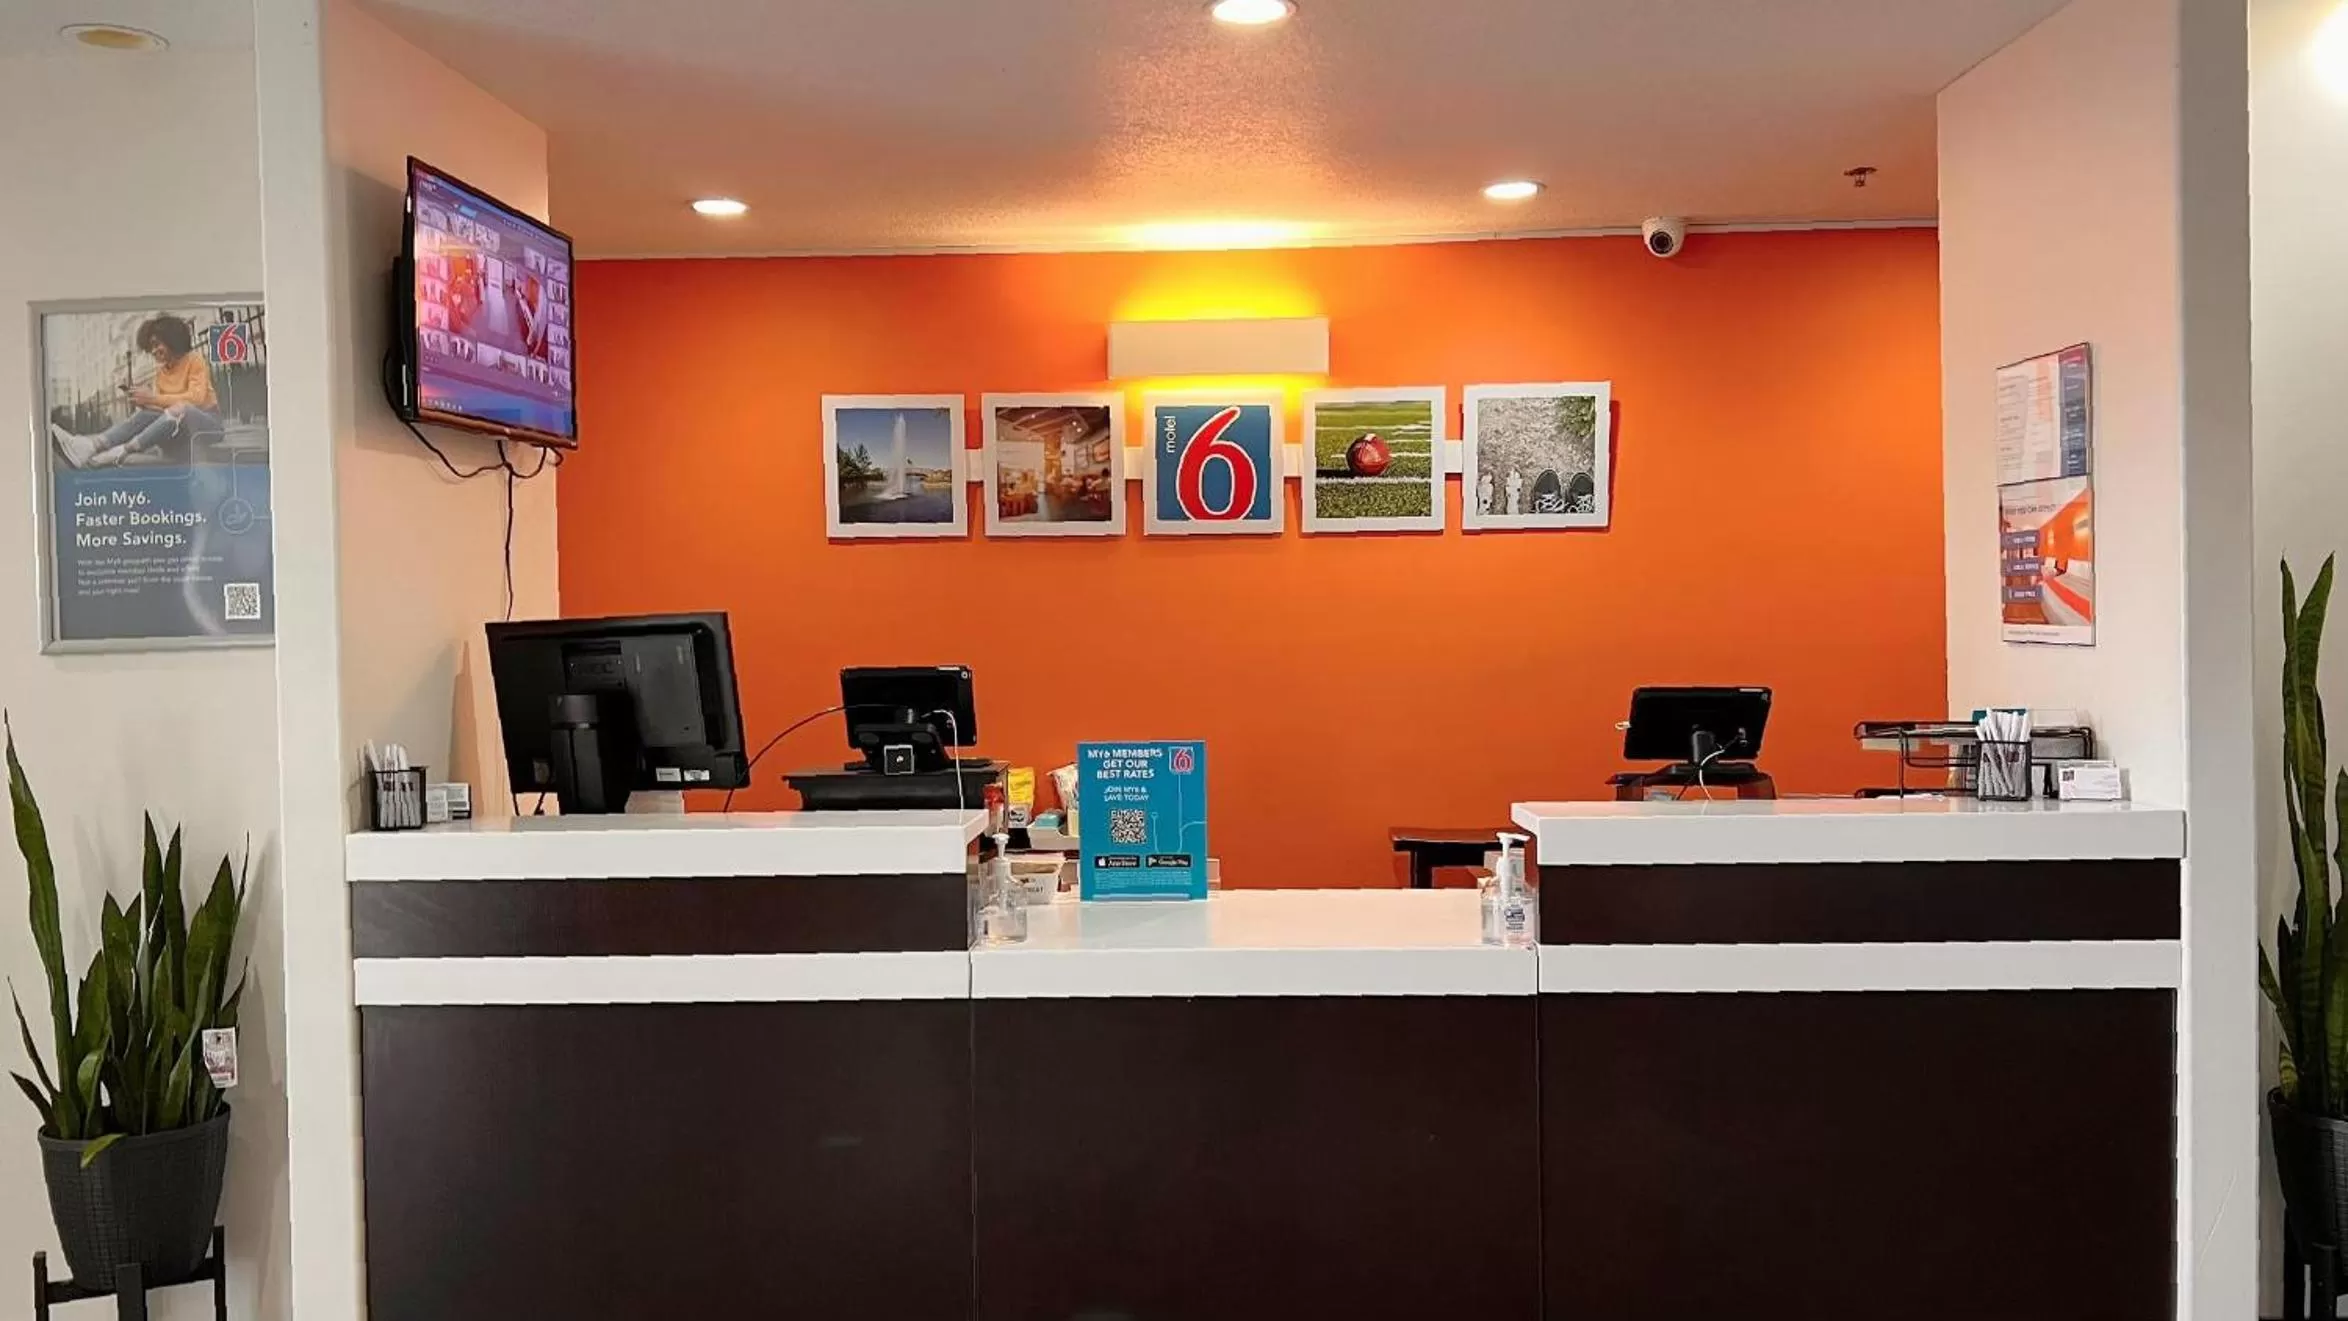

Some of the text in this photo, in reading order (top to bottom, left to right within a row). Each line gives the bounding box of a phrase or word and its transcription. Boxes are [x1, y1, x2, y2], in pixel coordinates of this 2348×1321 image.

[216, 323, 246, 363] 6
[1163, 415, 1176, 453] motel
[1176, 406, 1257, 521] 6
[75, 490, 151, 508] Join My6.
[76, 509, 207, 527] Faster Bookings.
[76, 530, 187, 548] More Savings.
[1112, 748, 1162, 758] MEMBERS
[1173, 749, 1193, 772] 6
[1103, 759, 1148, 769] GET OUR
[1096, 769, 1154, 779] BEST RATES
[1104, 785, 1121, 793] JOIN
[1104, 794, 1122, 802] SAVE
